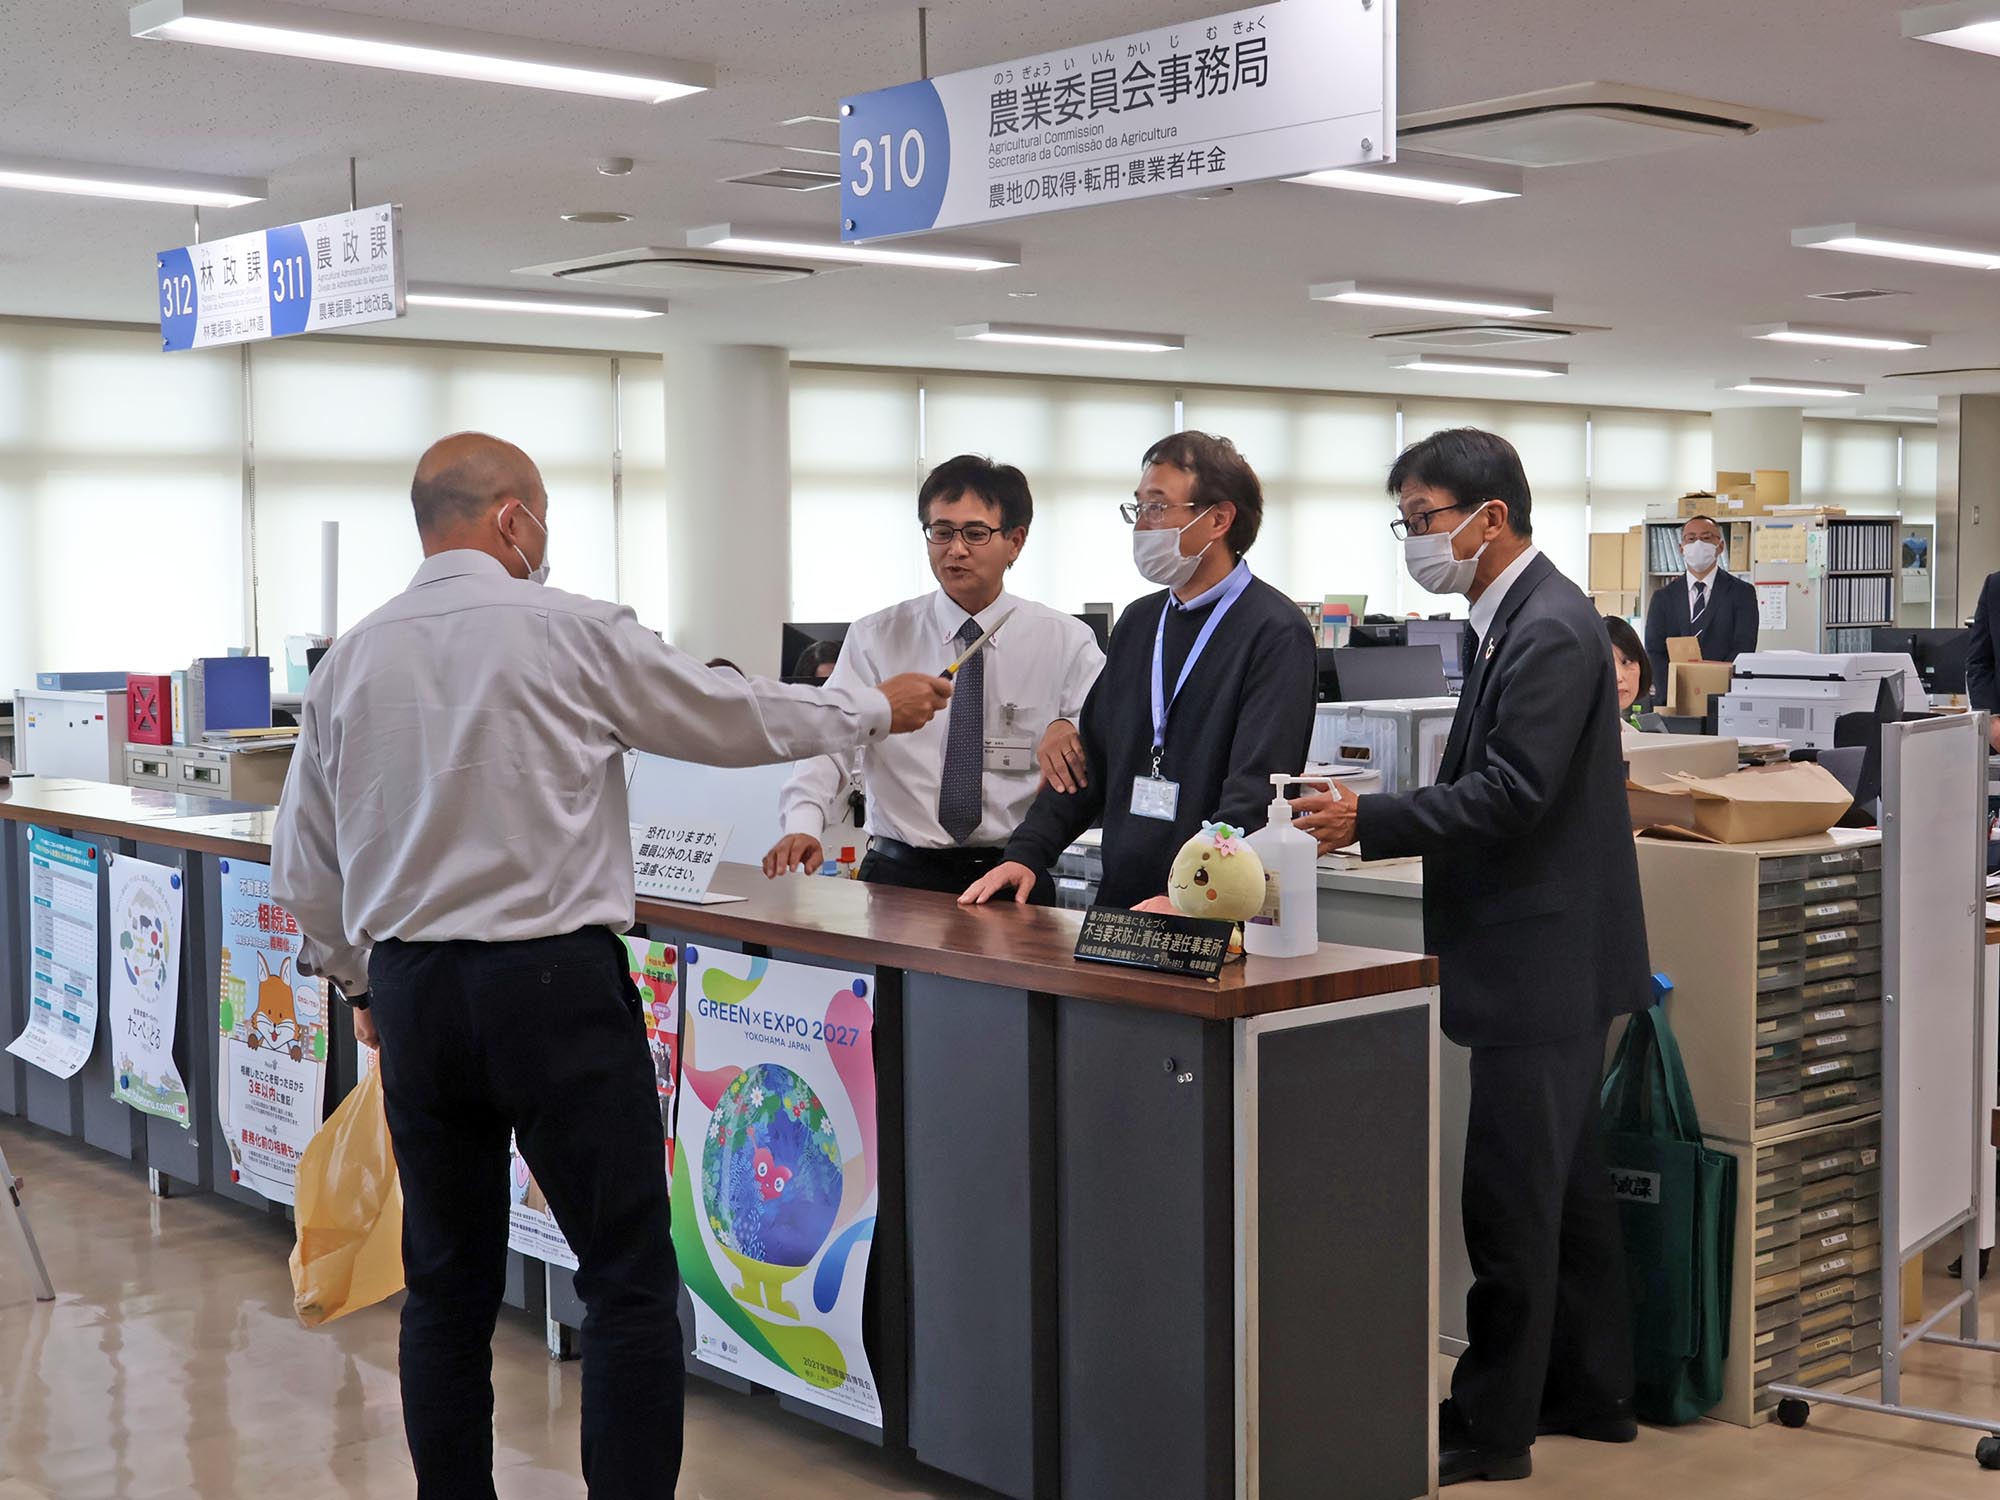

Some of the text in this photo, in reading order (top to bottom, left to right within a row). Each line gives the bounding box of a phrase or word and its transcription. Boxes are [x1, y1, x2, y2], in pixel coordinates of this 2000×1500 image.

[990, 37, 1268, 137] 農業委員会事務局
[988, 124, 1104, 155] Agricultural Commission
[988, 126, 1177, 169] Secretaria da Comissão da Agricultura
[851, 128, 925, 197] 310
[988, 145, 1226, 209] 農地の取得・転用・農業者年金
[317, 224, 388, 270] 農政課
[200, 250, 262, 292] 林政課
[272, 255, 305, 303] 311
[162, 275, 193, 318] 312
[638, 843, 713, 864] 職員以外の入室は
[646, 826, 717, 846] 恐れいりますが、
[1083, 923, 1224, 958] 不当要求防止責任者選任事業所
[1089, 911, 1168, 930] 暴力団対策法にもとづく
[744, 1031, 811, 1053] YOKOHAMA JAPAN
[812, 1020, 860, 1047] 2027
